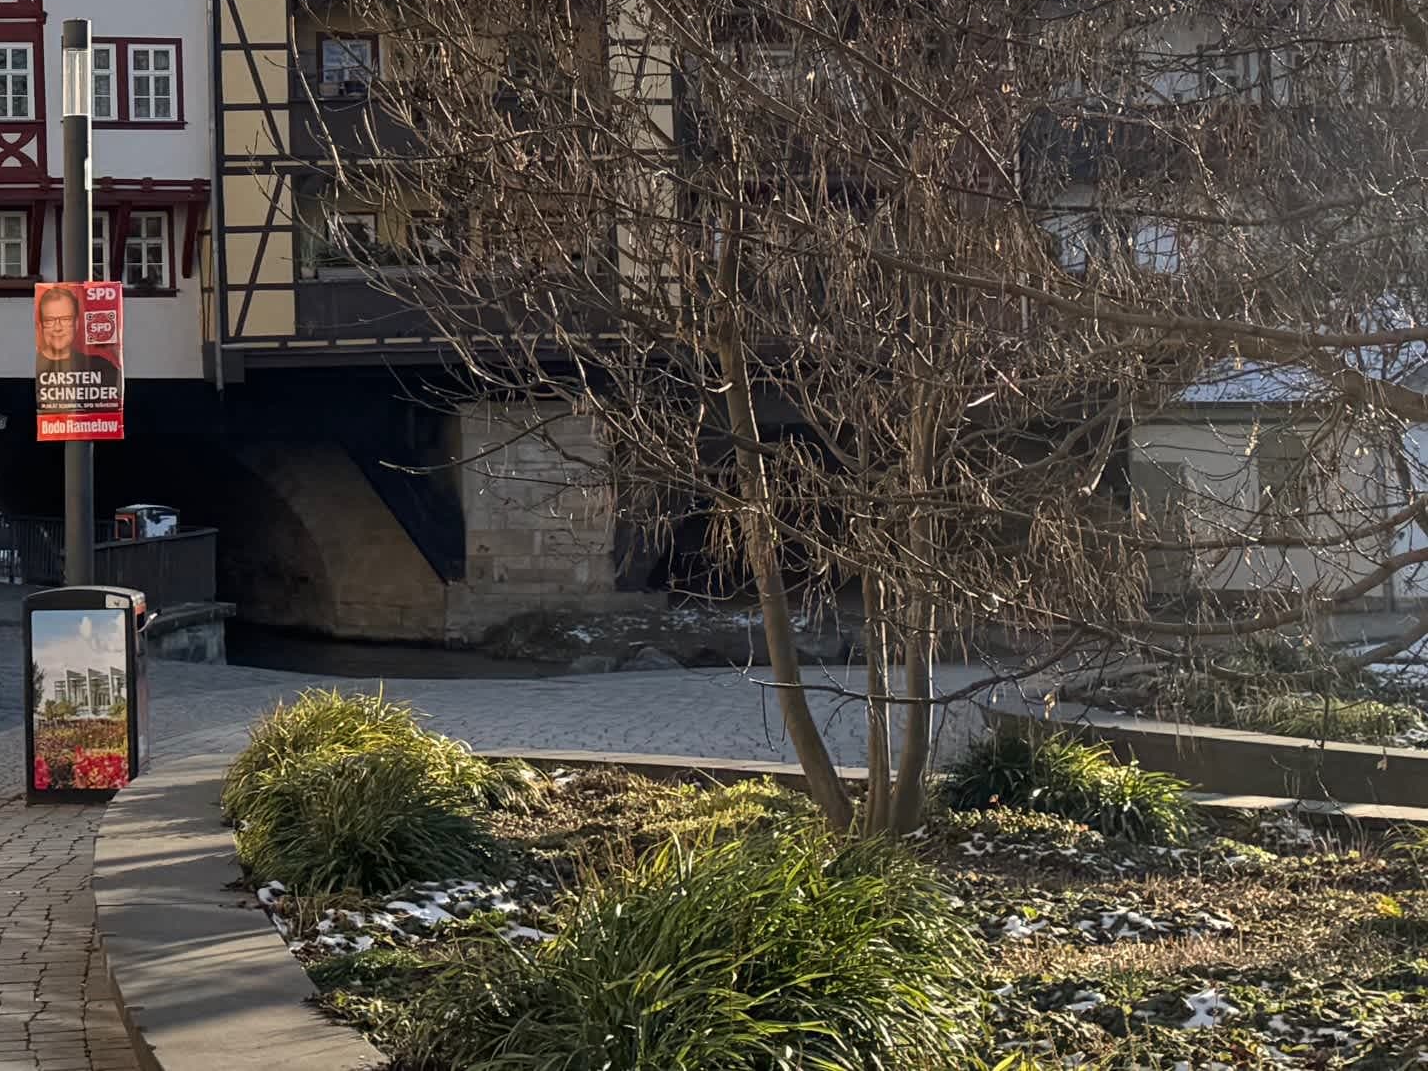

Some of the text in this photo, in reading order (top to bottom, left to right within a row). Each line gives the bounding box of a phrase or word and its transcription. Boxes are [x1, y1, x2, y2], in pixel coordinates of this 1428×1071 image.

[86, 287, 116, 301] SPD
[90, 322, 112, 332] SPD
[39, 371, 102, 385] CARSTEN
[39, 386, 118, 401] SCHNEIDER
[41, 418, 118, 435] Bodo Ramelow
